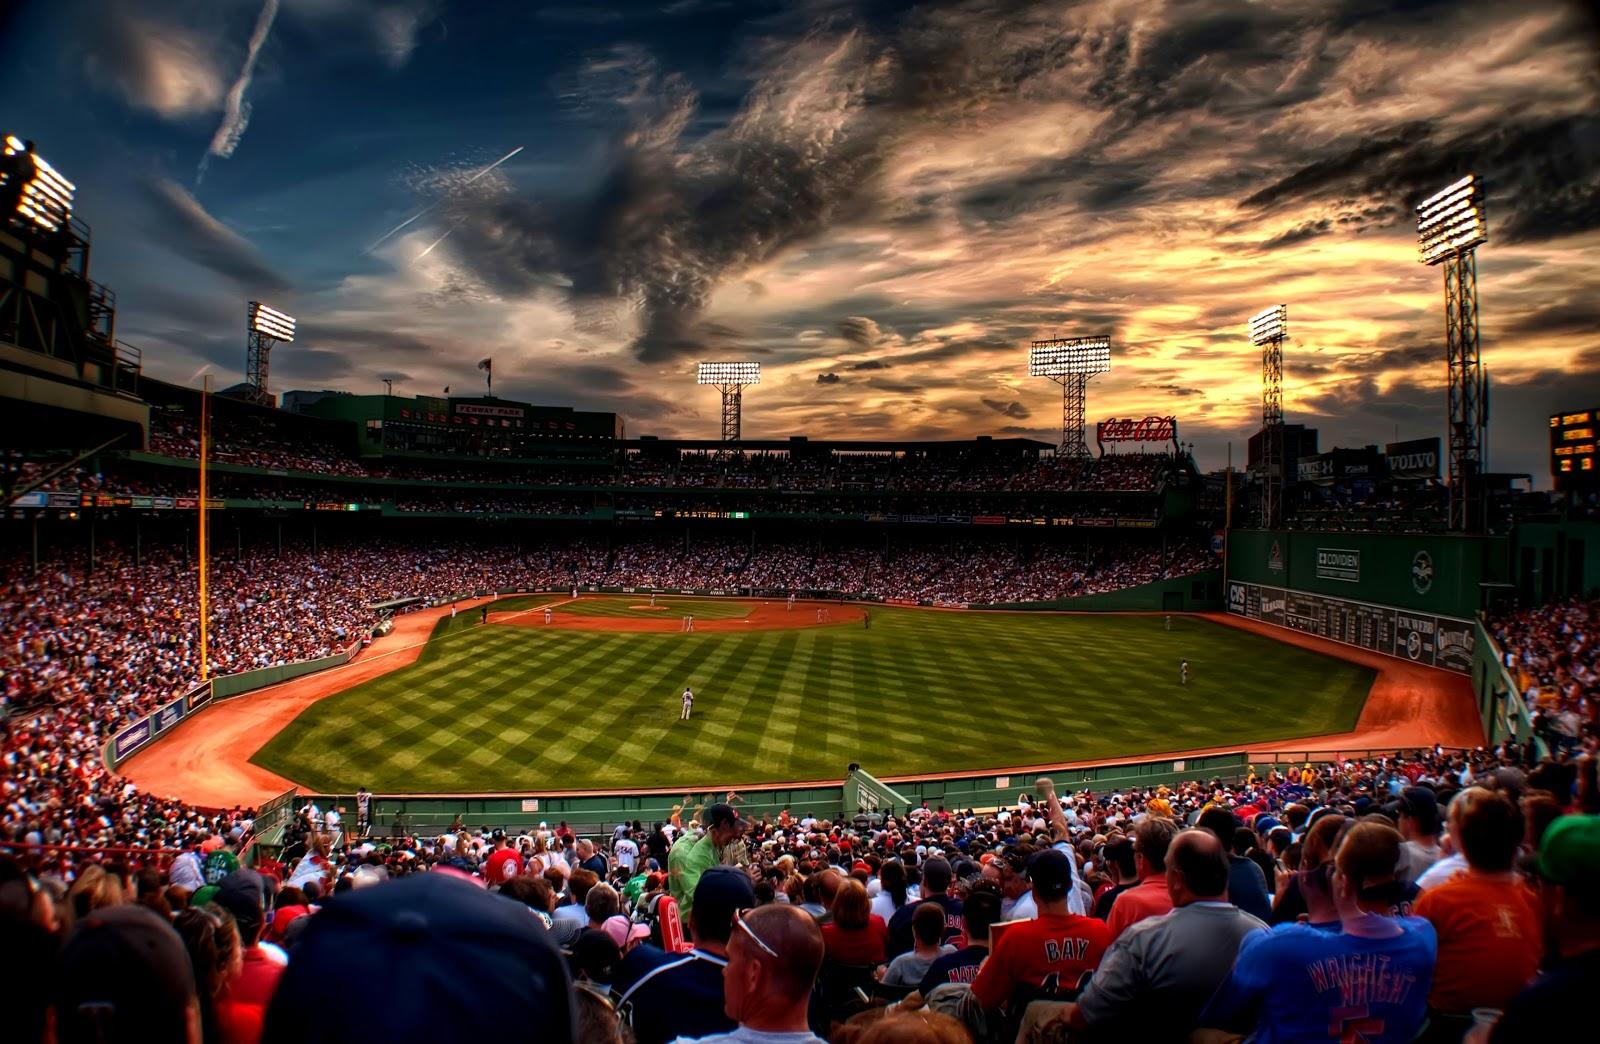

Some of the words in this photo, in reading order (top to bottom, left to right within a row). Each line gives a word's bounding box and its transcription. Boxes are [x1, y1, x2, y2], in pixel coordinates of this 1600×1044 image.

[461, 406, 494, 414] FENWAY
[498, 408, 520, 416] PARK
[1388, 451, 1436, 471] VOLVO
[1328, 553, 1358, 567] COVIDIEN
[1230, 584, 1245, 604] CVS
[1044, 937, 1090, 963] BAY
[1306, 952, 1392, 994] WRIGHT
